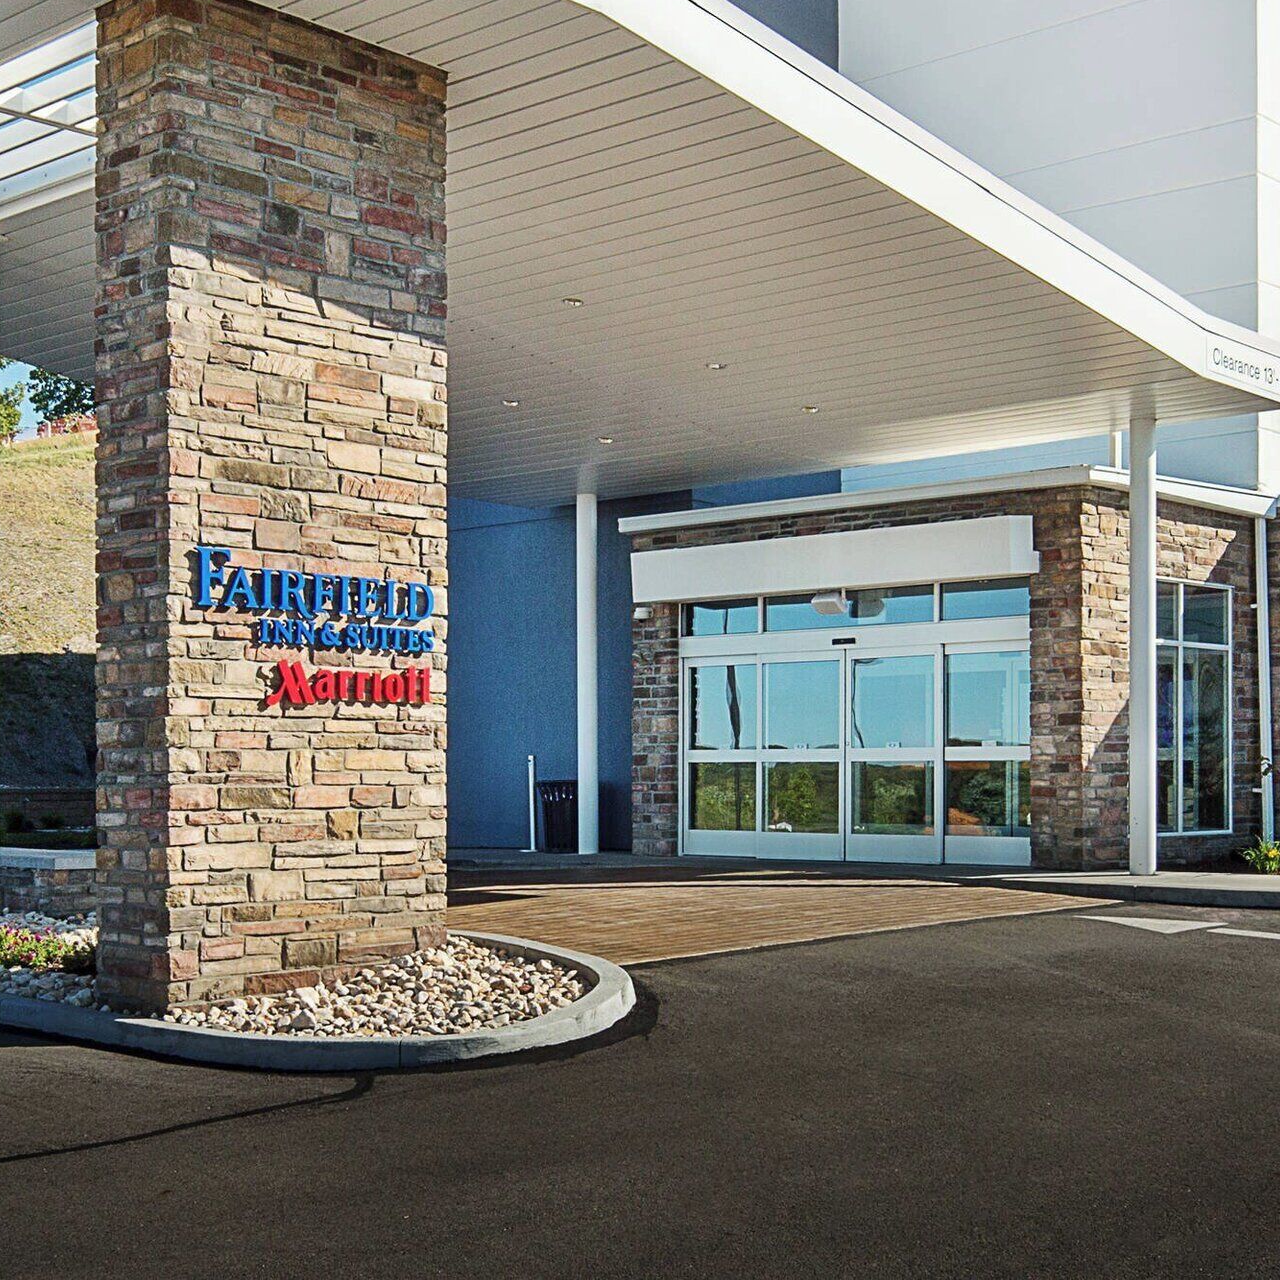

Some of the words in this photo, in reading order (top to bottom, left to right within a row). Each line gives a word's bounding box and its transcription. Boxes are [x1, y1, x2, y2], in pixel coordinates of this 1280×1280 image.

[1212, 347, 1261, 380] Clearance
[195, 545, 435, 621] FAIRFIELD
[259, 617, 316, 645] INN
[320, 621, 342, 647] &
[344, 622, 435, 652] SUITES
[266, 658, 433, 706] Marriott
